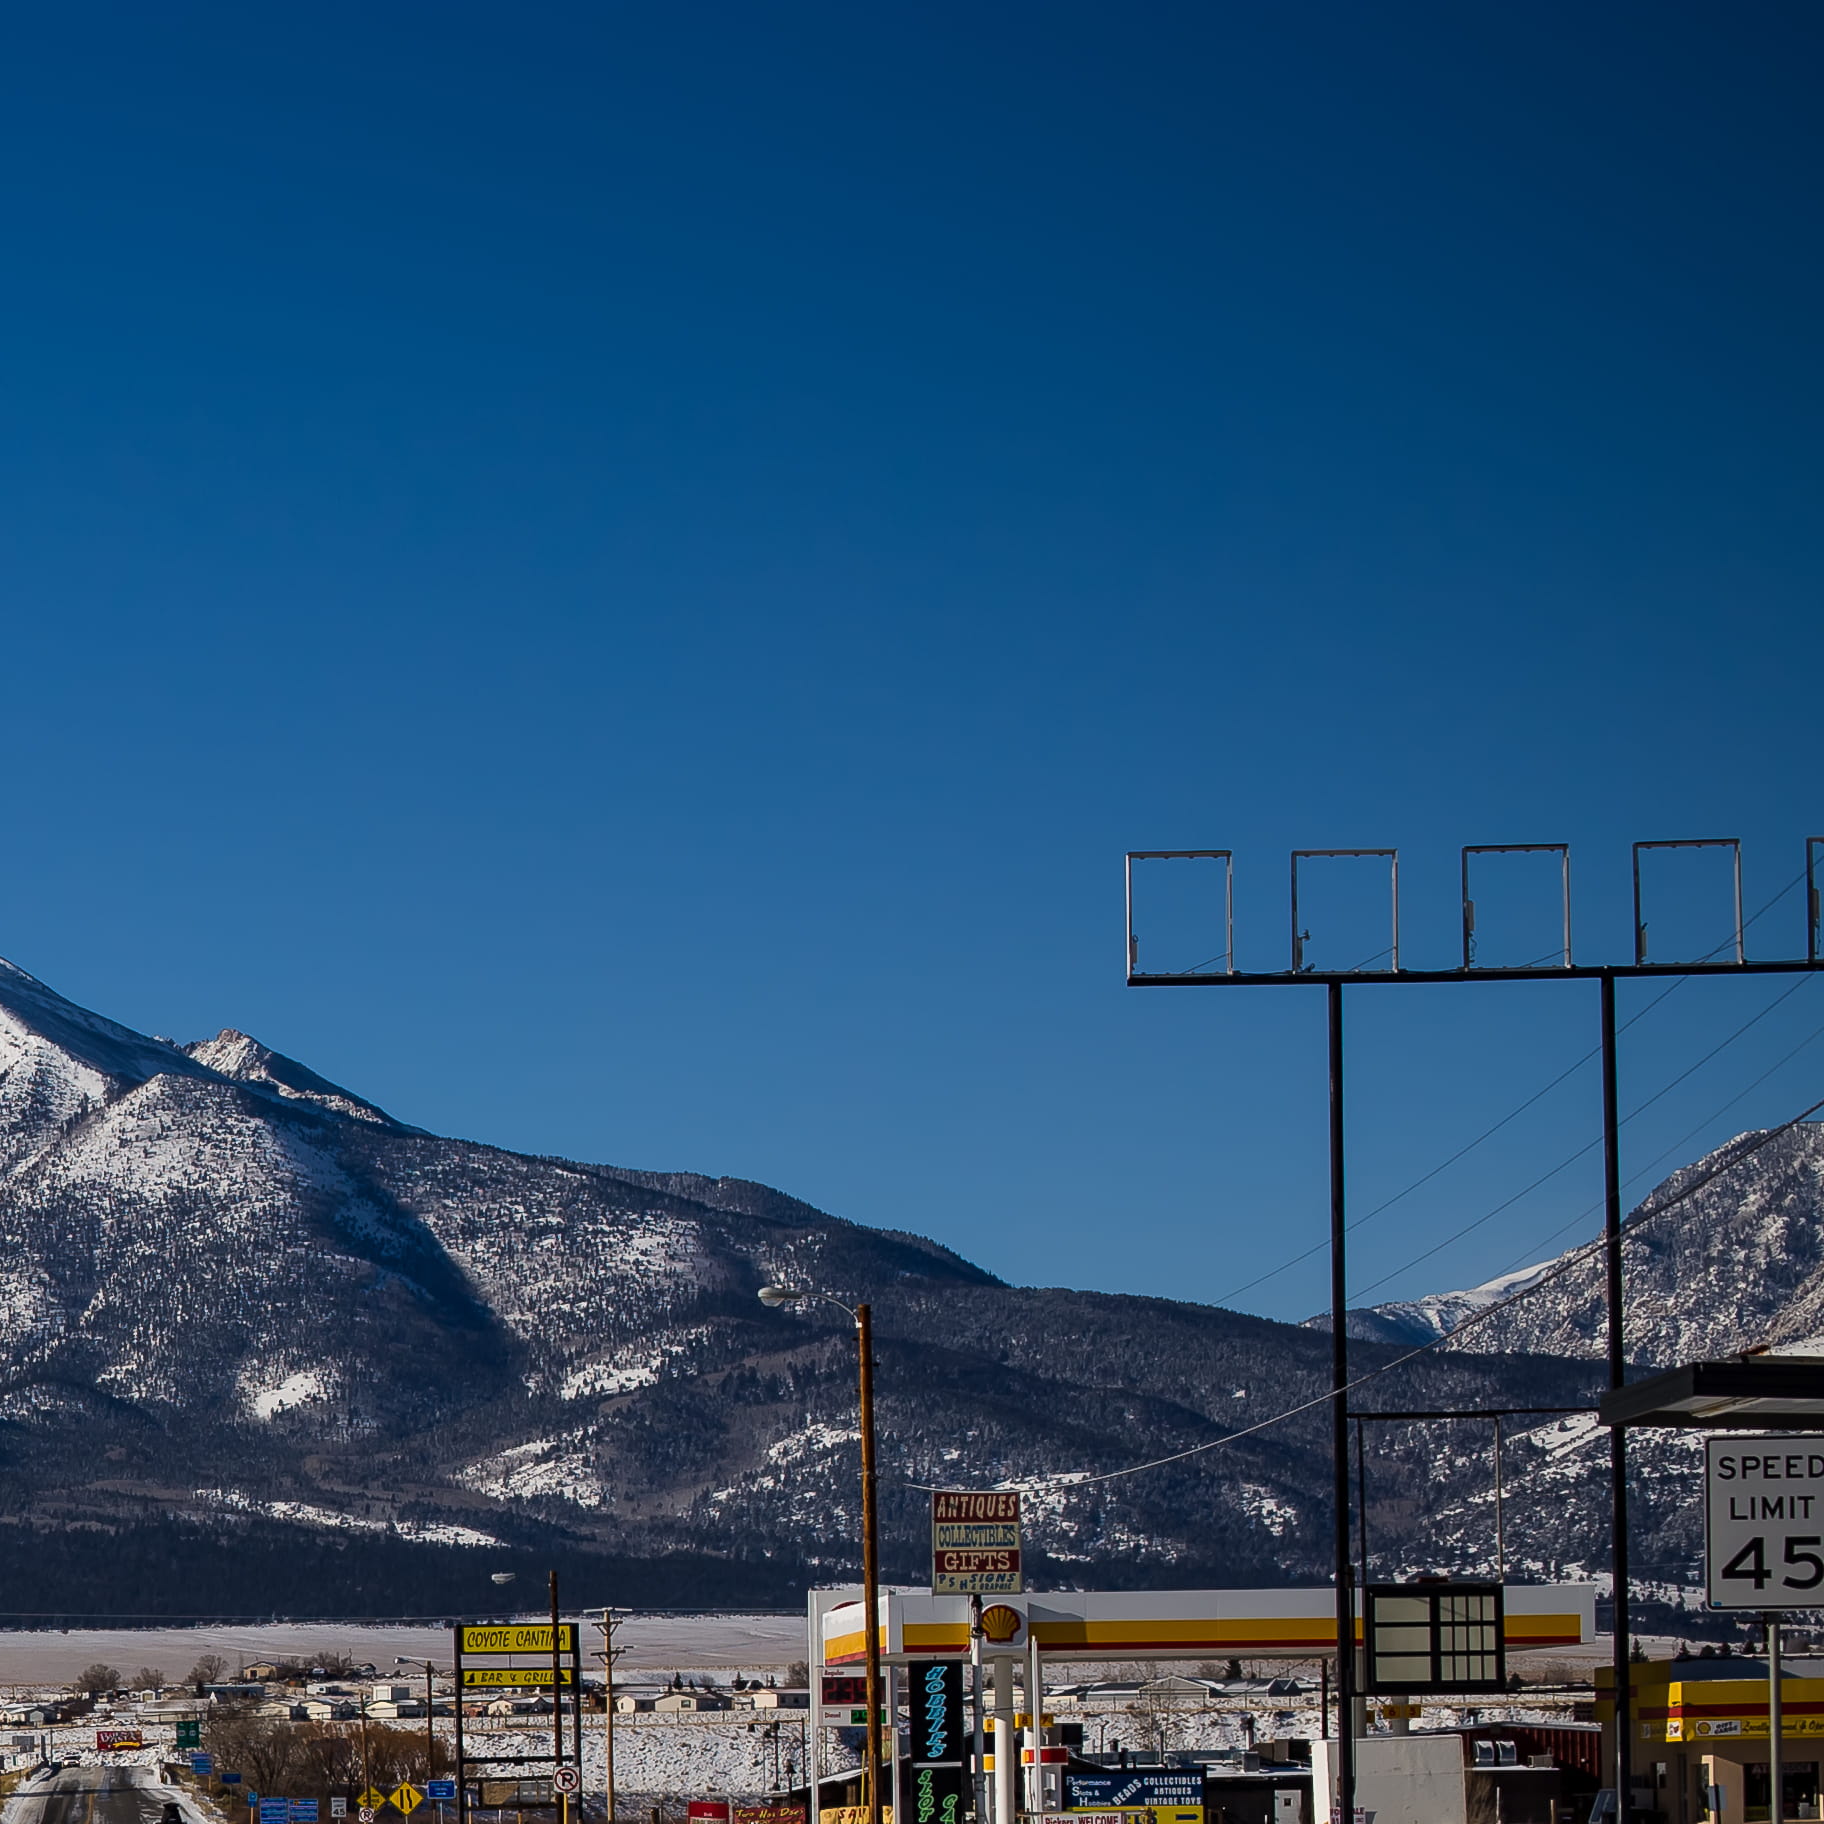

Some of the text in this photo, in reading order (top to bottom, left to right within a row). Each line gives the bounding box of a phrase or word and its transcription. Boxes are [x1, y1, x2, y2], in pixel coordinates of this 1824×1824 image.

[1717, 1455, 1824, 1480] SPEED
[937, 1494, 1017, 1519] ANTIQUES
[1730, 1495, 1815, 1520] LIMIT
[938, 1524, 1016, 1548] COLLECTIBLES
[944, 1551, 1011, 1571] GIFTS
[1721, 1536, 1824, 1589] 45
[969, 1573, 1017, 1583] SIGNS
[467, 1630, 511, 1648] COYOTE
[480, 1672, 503, 1683] BAR
[925, 1666, 948, 1758] HOBBIES
[1066, 1776, 1112, 1786] Performance
[1143, 1776, 1202, 1786] COLLECTIBLES
[917, 1769, 935, 1823] SLOT
[1071, 1786, 1093, 1797] Slots
[1111, 1778, 1143, 1806] BEADS
[1153, 1787, 1192, 1796] ANTIQUES
[1079, 1796, 1112, 1807] Hobbies
[1144, 1796, 1202, 1806] VINTAGE TOYS
[332, 1808, 346, 1816] 45
